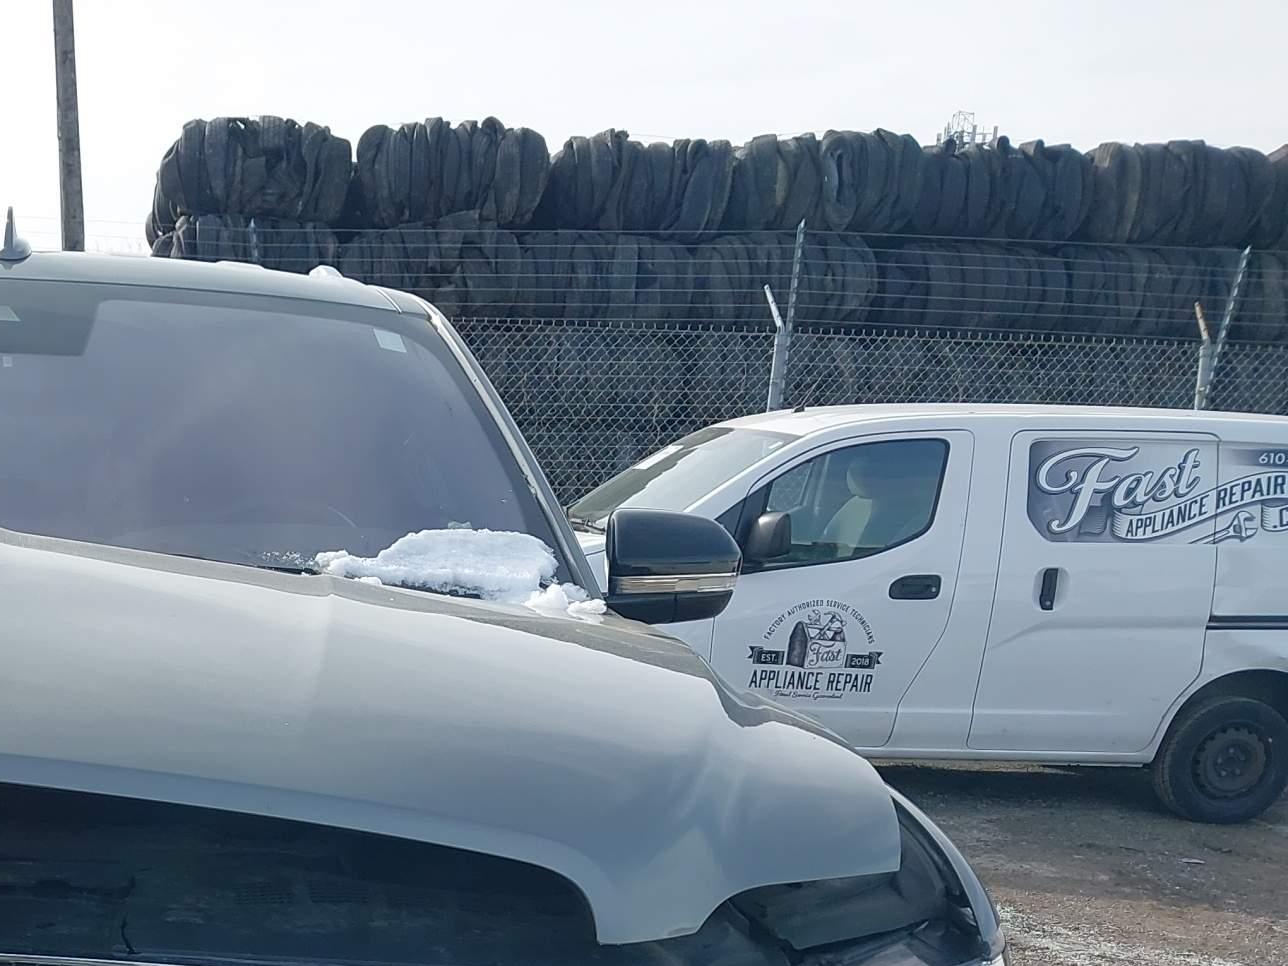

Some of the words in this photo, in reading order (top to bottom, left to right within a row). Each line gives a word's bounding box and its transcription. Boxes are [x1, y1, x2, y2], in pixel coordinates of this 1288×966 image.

[1036, 446, 1201, 534] Fast
[1125, 496, 1209, 538] APPLIANCE
[1215, 474, 1287, 510] REPAIR
[764, 614, 787, 640] FACTORY
[787, 599, 824, 617] AUTHORIZED
[826, 599, 851, 613] SERVICE
[850, 608, 875, 645] TECHNICIANS
[761, 653, 777, 662] EST.
[809, 641, 842, 666] Fast
[851, 656, 870, 666] 2018
[748, 669, 824, 691] APPLIANCE
[826, 672, 874, 693] REPAIR
